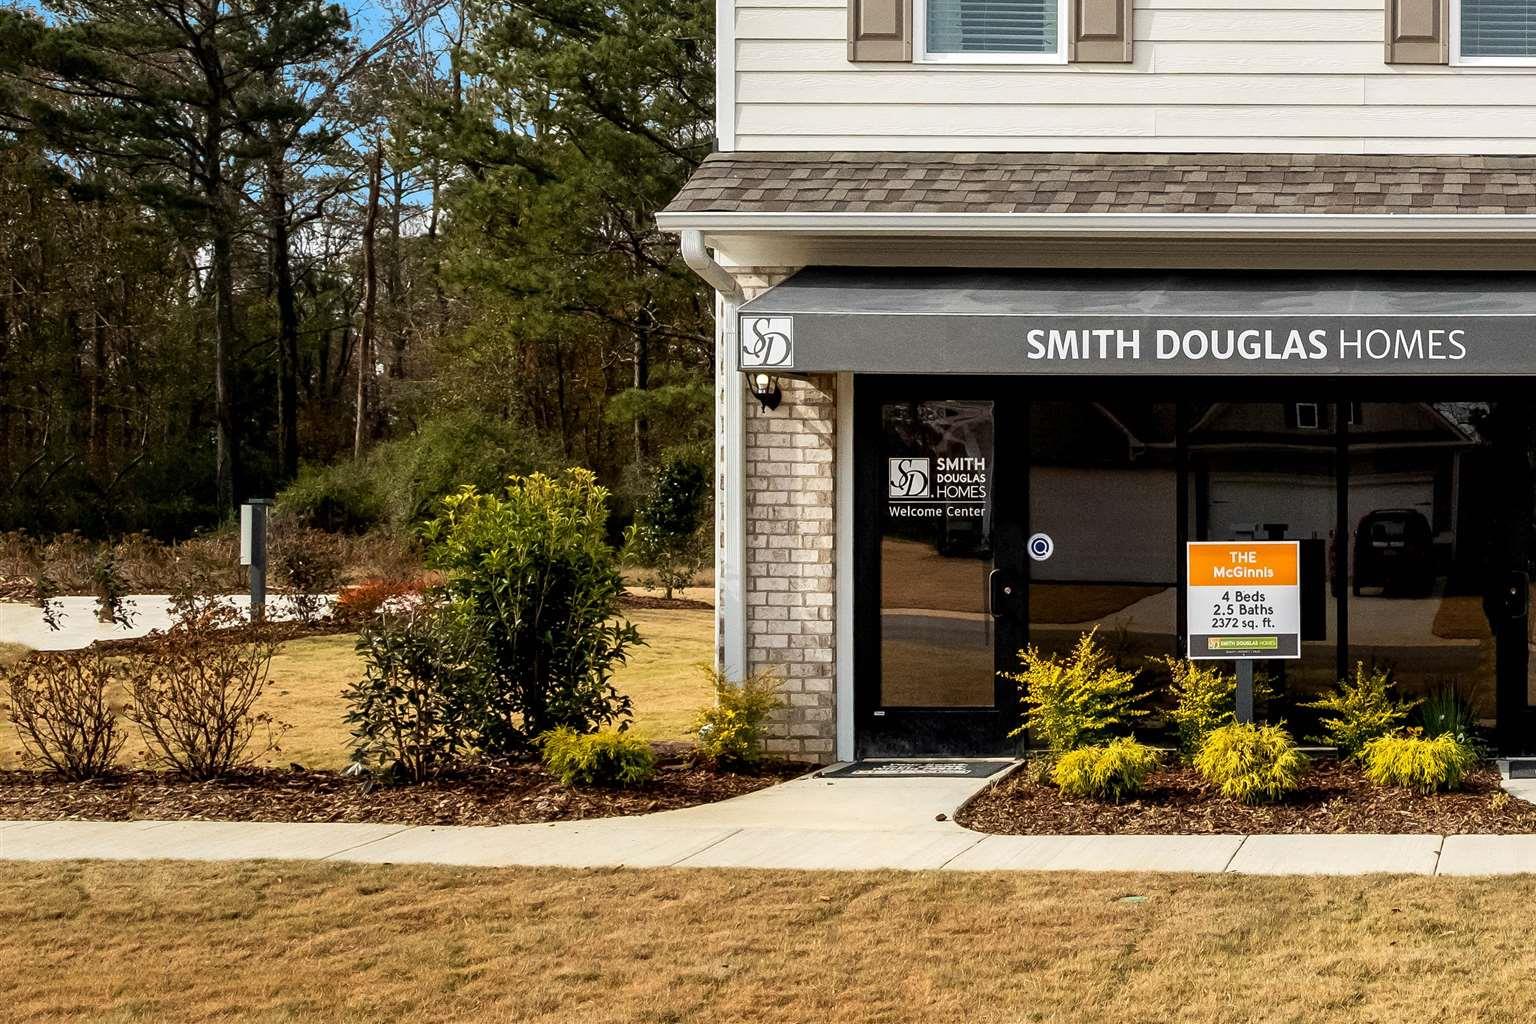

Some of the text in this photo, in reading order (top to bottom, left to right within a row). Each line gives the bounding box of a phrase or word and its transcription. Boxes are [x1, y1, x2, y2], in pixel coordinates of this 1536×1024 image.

[1026, 329, 1467, 360] SMITH DOUGLAS HOMES
[937, 457, 985, 471] SMITH
[937, 474, 986, 483] DOUGLAS
[936, 485, 987, 498] HOMES
[889, 505, 986, 517] Welcome Center
[1229, 551, 1257, 563] THE
[1213, 566, 1274, 578] McGinnis
[1222, 591, 1266, 602] 4 Beds
[1213, 604, 1274, 616] 2.5 Baths
[1211, 617, 1275, 630] 2372 sq. ft.
